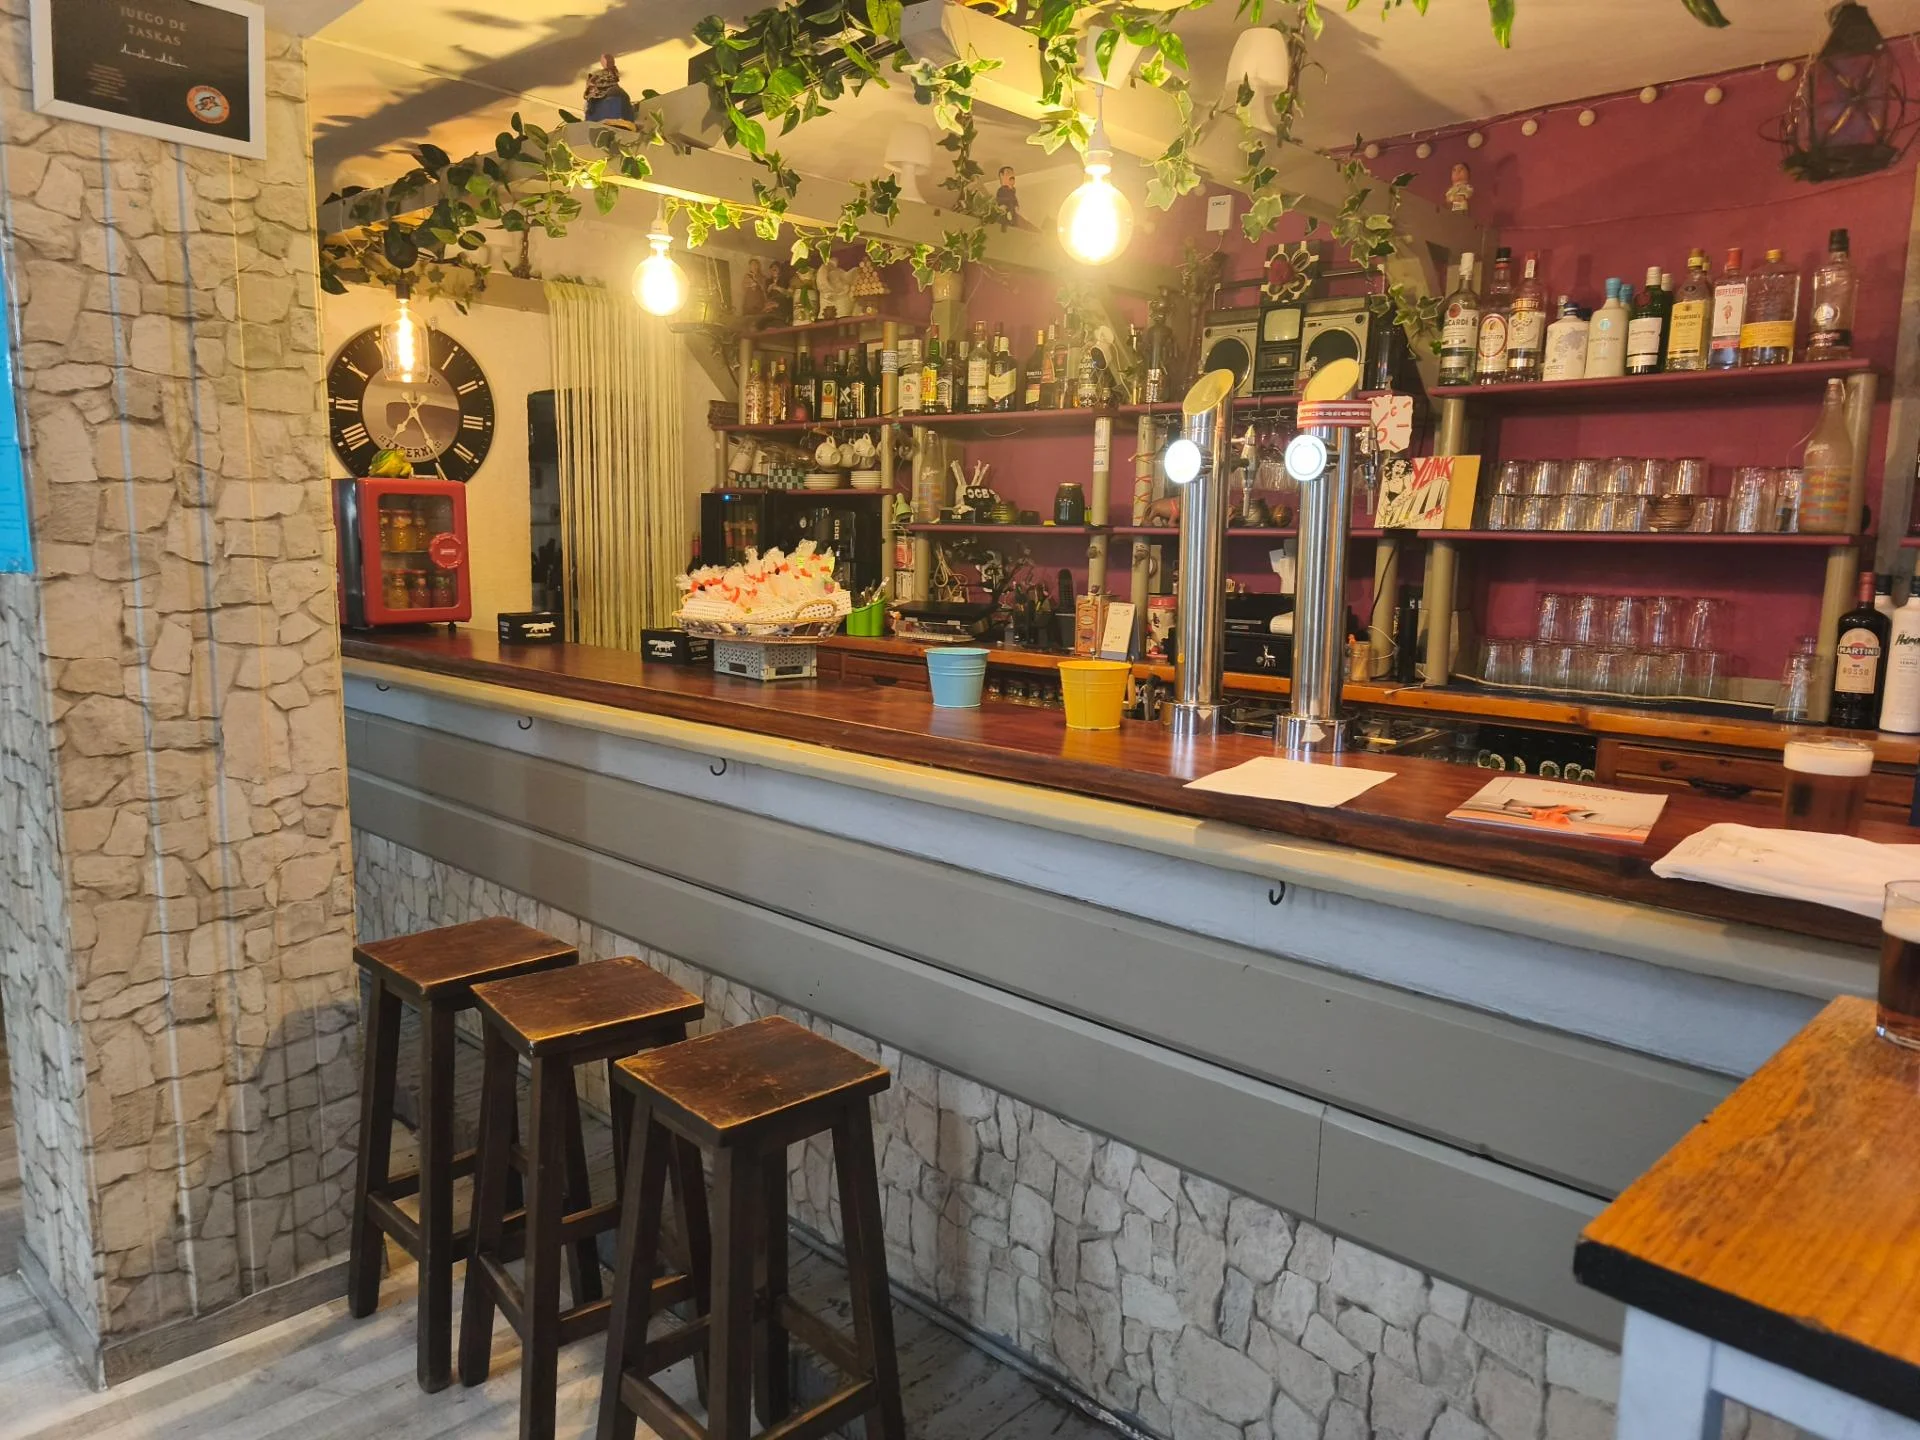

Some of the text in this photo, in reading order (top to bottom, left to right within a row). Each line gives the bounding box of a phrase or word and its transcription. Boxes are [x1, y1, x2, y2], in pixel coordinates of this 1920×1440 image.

[120, 7, 188, 32] JUEGO DE
[127, 25, 182, 46] TASKAS
[967, 488, 990, 499] OCB
[1839, 647, 1879, 656] MARTINI
